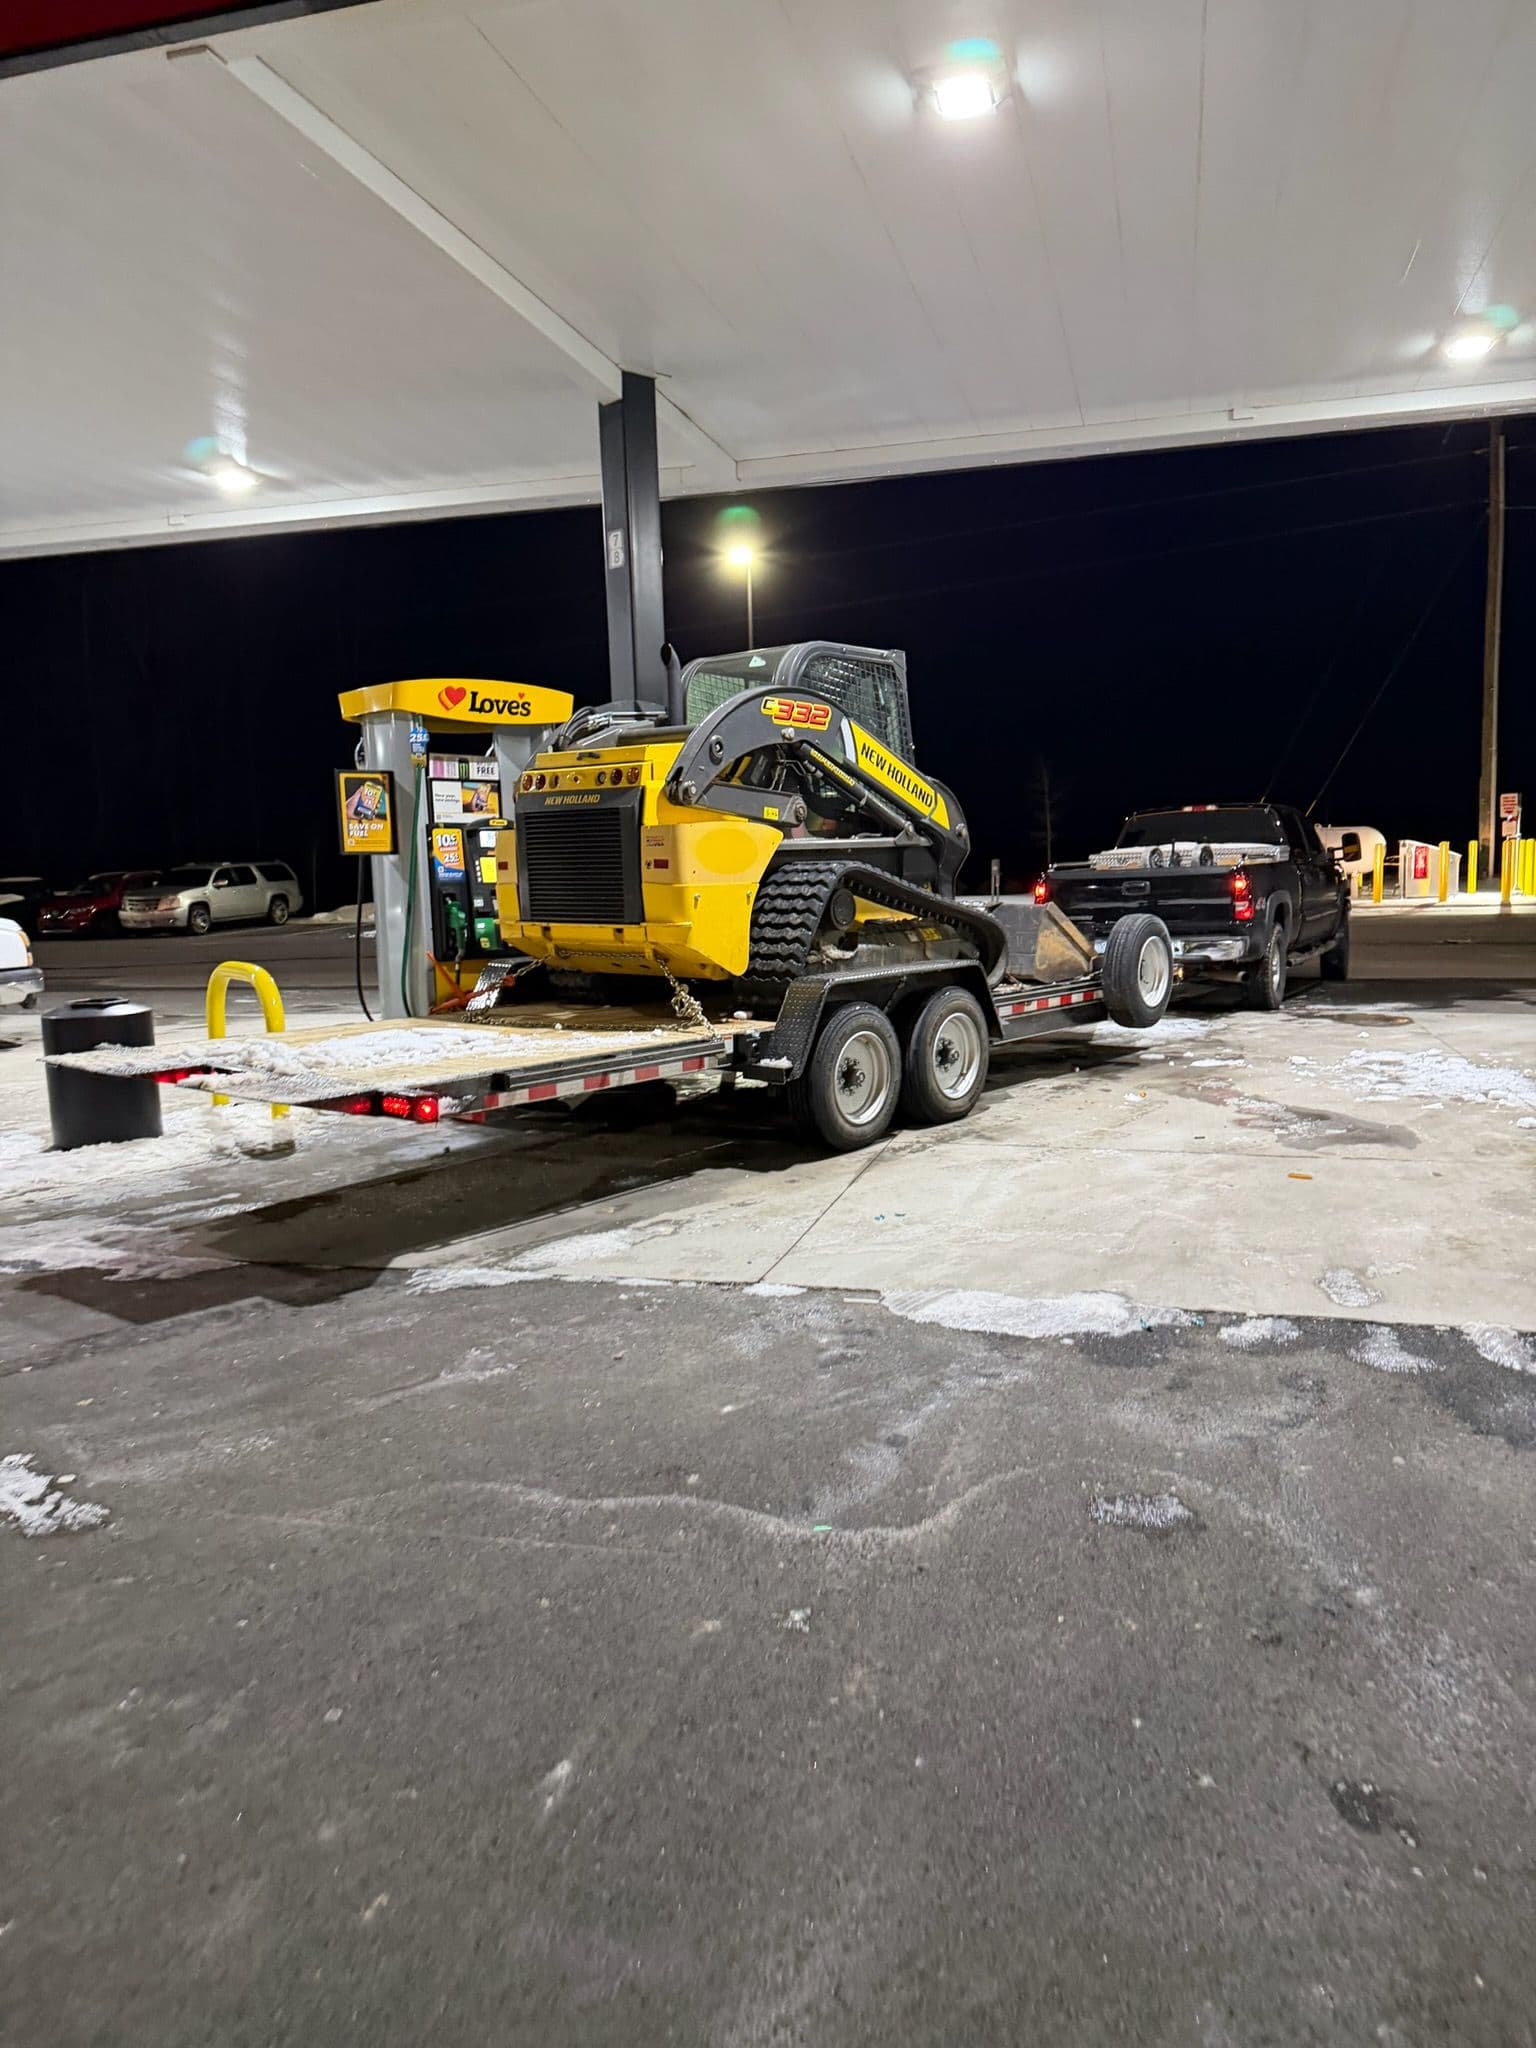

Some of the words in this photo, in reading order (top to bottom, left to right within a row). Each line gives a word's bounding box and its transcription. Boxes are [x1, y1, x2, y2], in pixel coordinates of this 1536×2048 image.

[476, 766, 496, 776] FREE
[860, 741, 886, 772] NEW
[886, 762, 934, 809] HOLLAND
[544, 795, 564, 806] NEW
[562, 793, 601, 805] HOLLAND
[348, 823, 369, 831] SAVE
[370, 823, 384, 831] ON
[349, 830, 369, 838] FUEL
